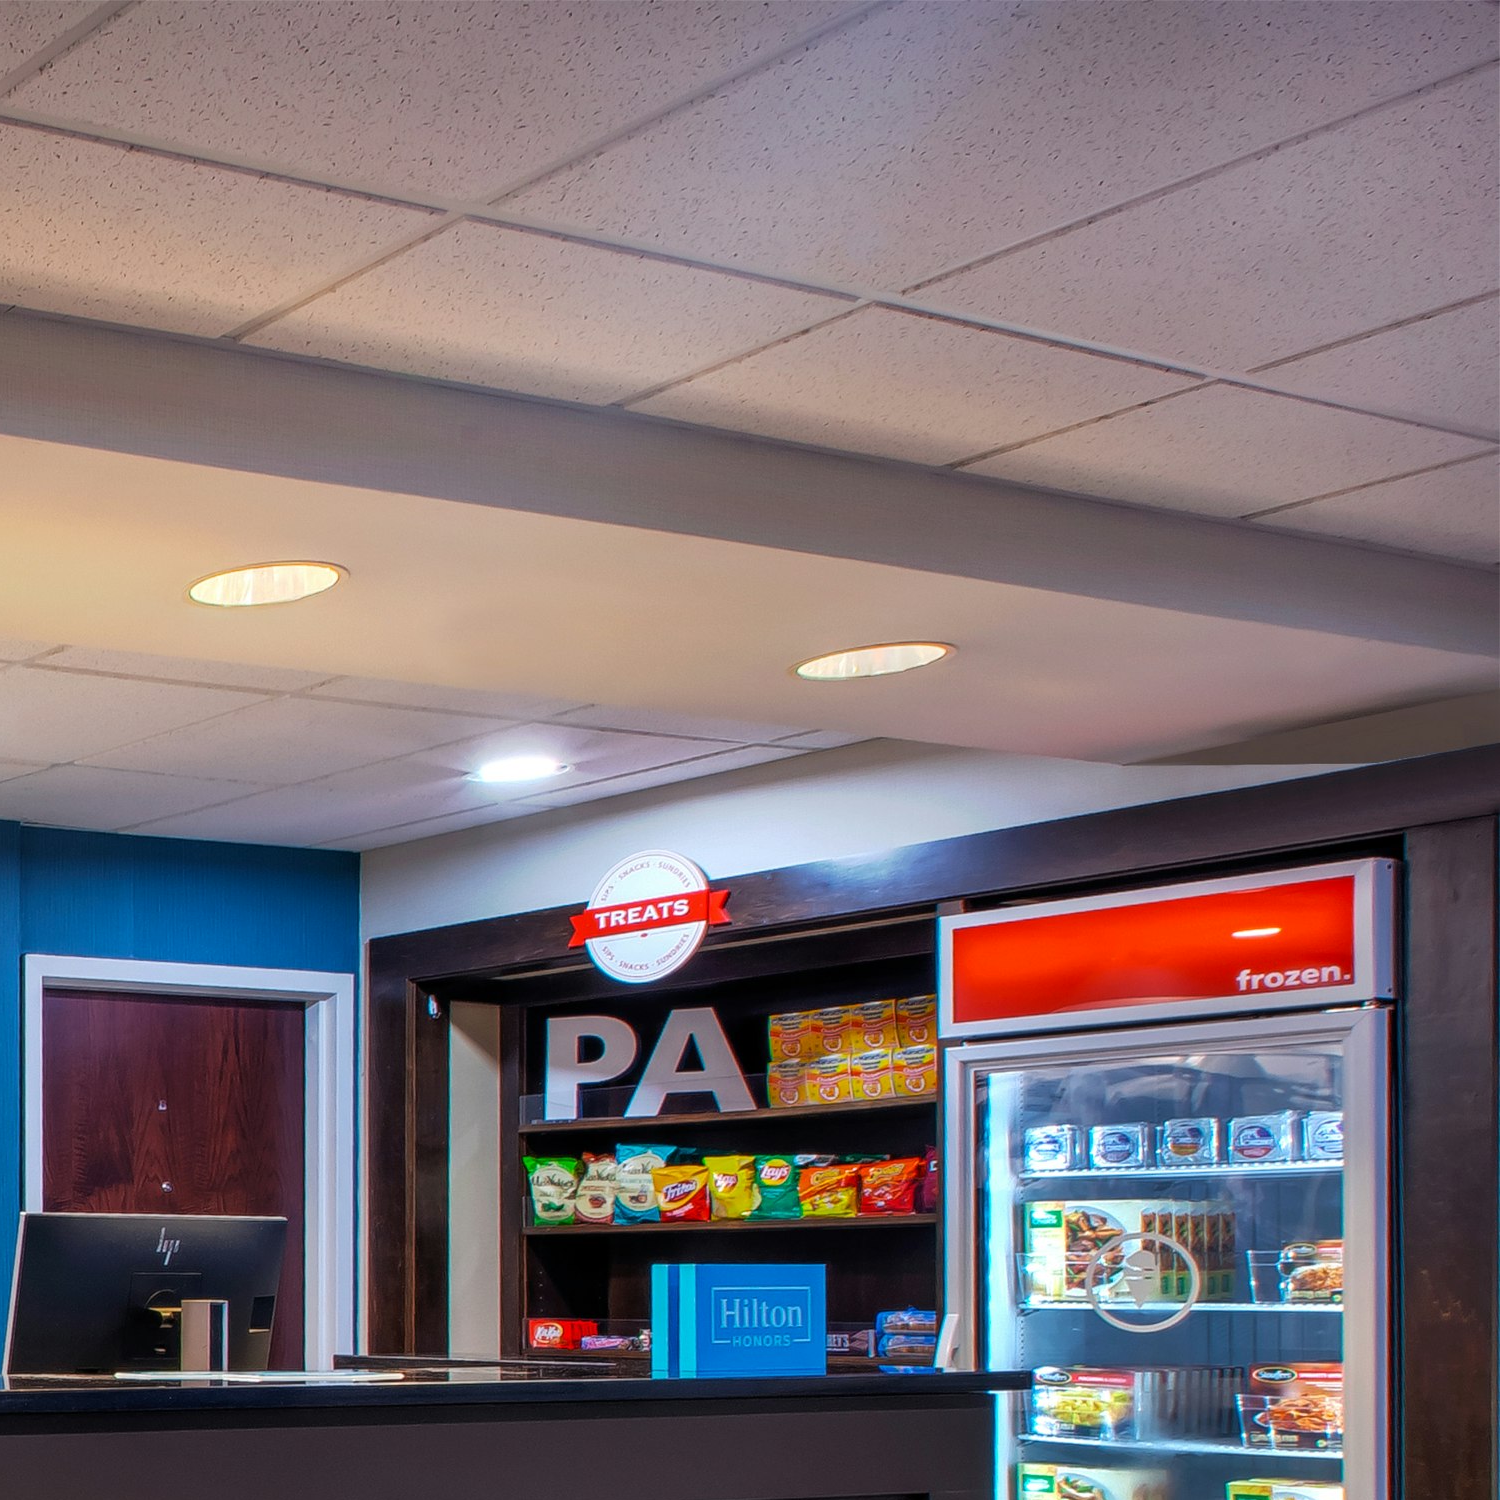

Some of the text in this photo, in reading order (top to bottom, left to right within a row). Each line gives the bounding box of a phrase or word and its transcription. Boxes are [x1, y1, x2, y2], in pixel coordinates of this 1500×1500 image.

[618, 861, 650, 880] SNACKS
[658, 861, 691, 888] SUNDRIES
[594, 899, 689, 929] TREATS
[602, 933, 689, 971] SIPS SNACKS SUNDRIES
[1236, 965, 1353, 991] frozen.
[544, 1007, 758, 1120] PA
[719, 1298, 803, 1328] Hilton
[732, 1334, 792, 1347] HONORS
